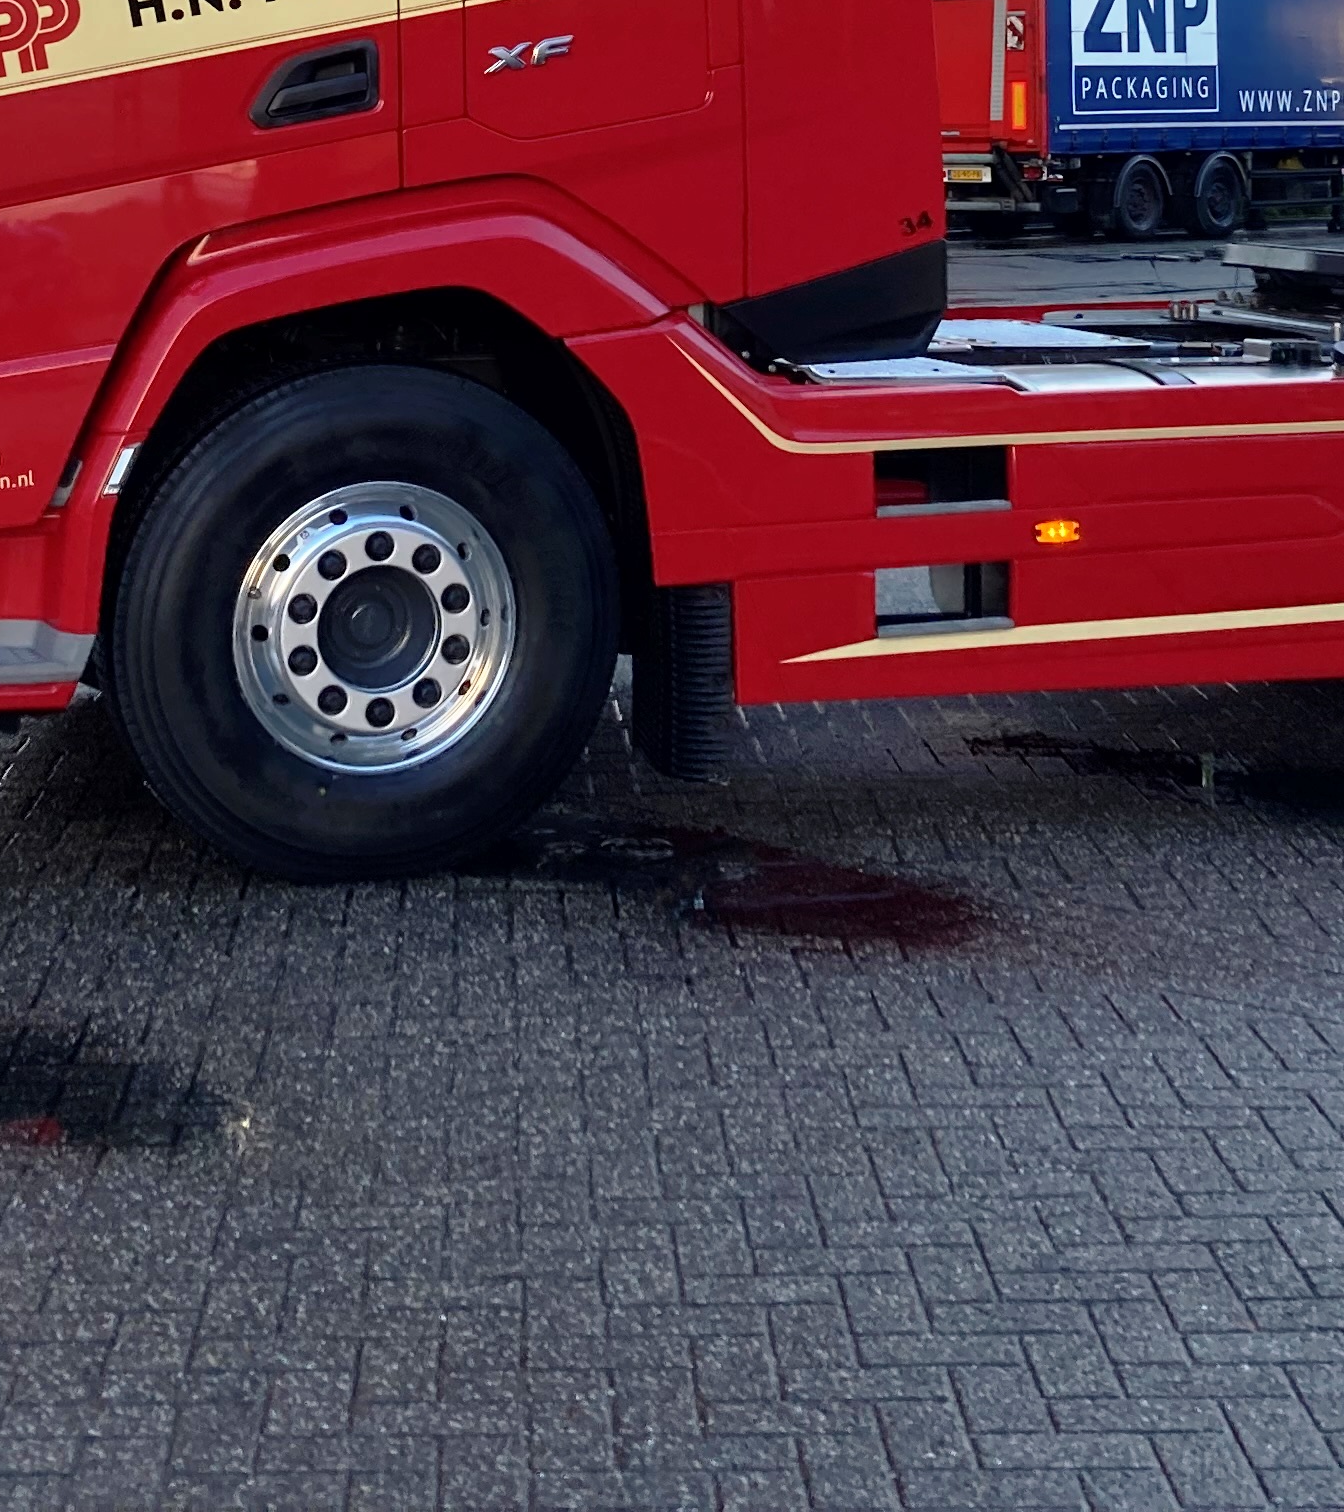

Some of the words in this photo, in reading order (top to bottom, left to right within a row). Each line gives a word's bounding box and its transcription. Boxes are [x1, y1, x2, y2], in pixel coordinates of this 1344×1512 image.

[483, 34, 575, 75] XF
[1081, 76, 1209, 99] PACKAGING
[897, 210, 934, 237] 34
